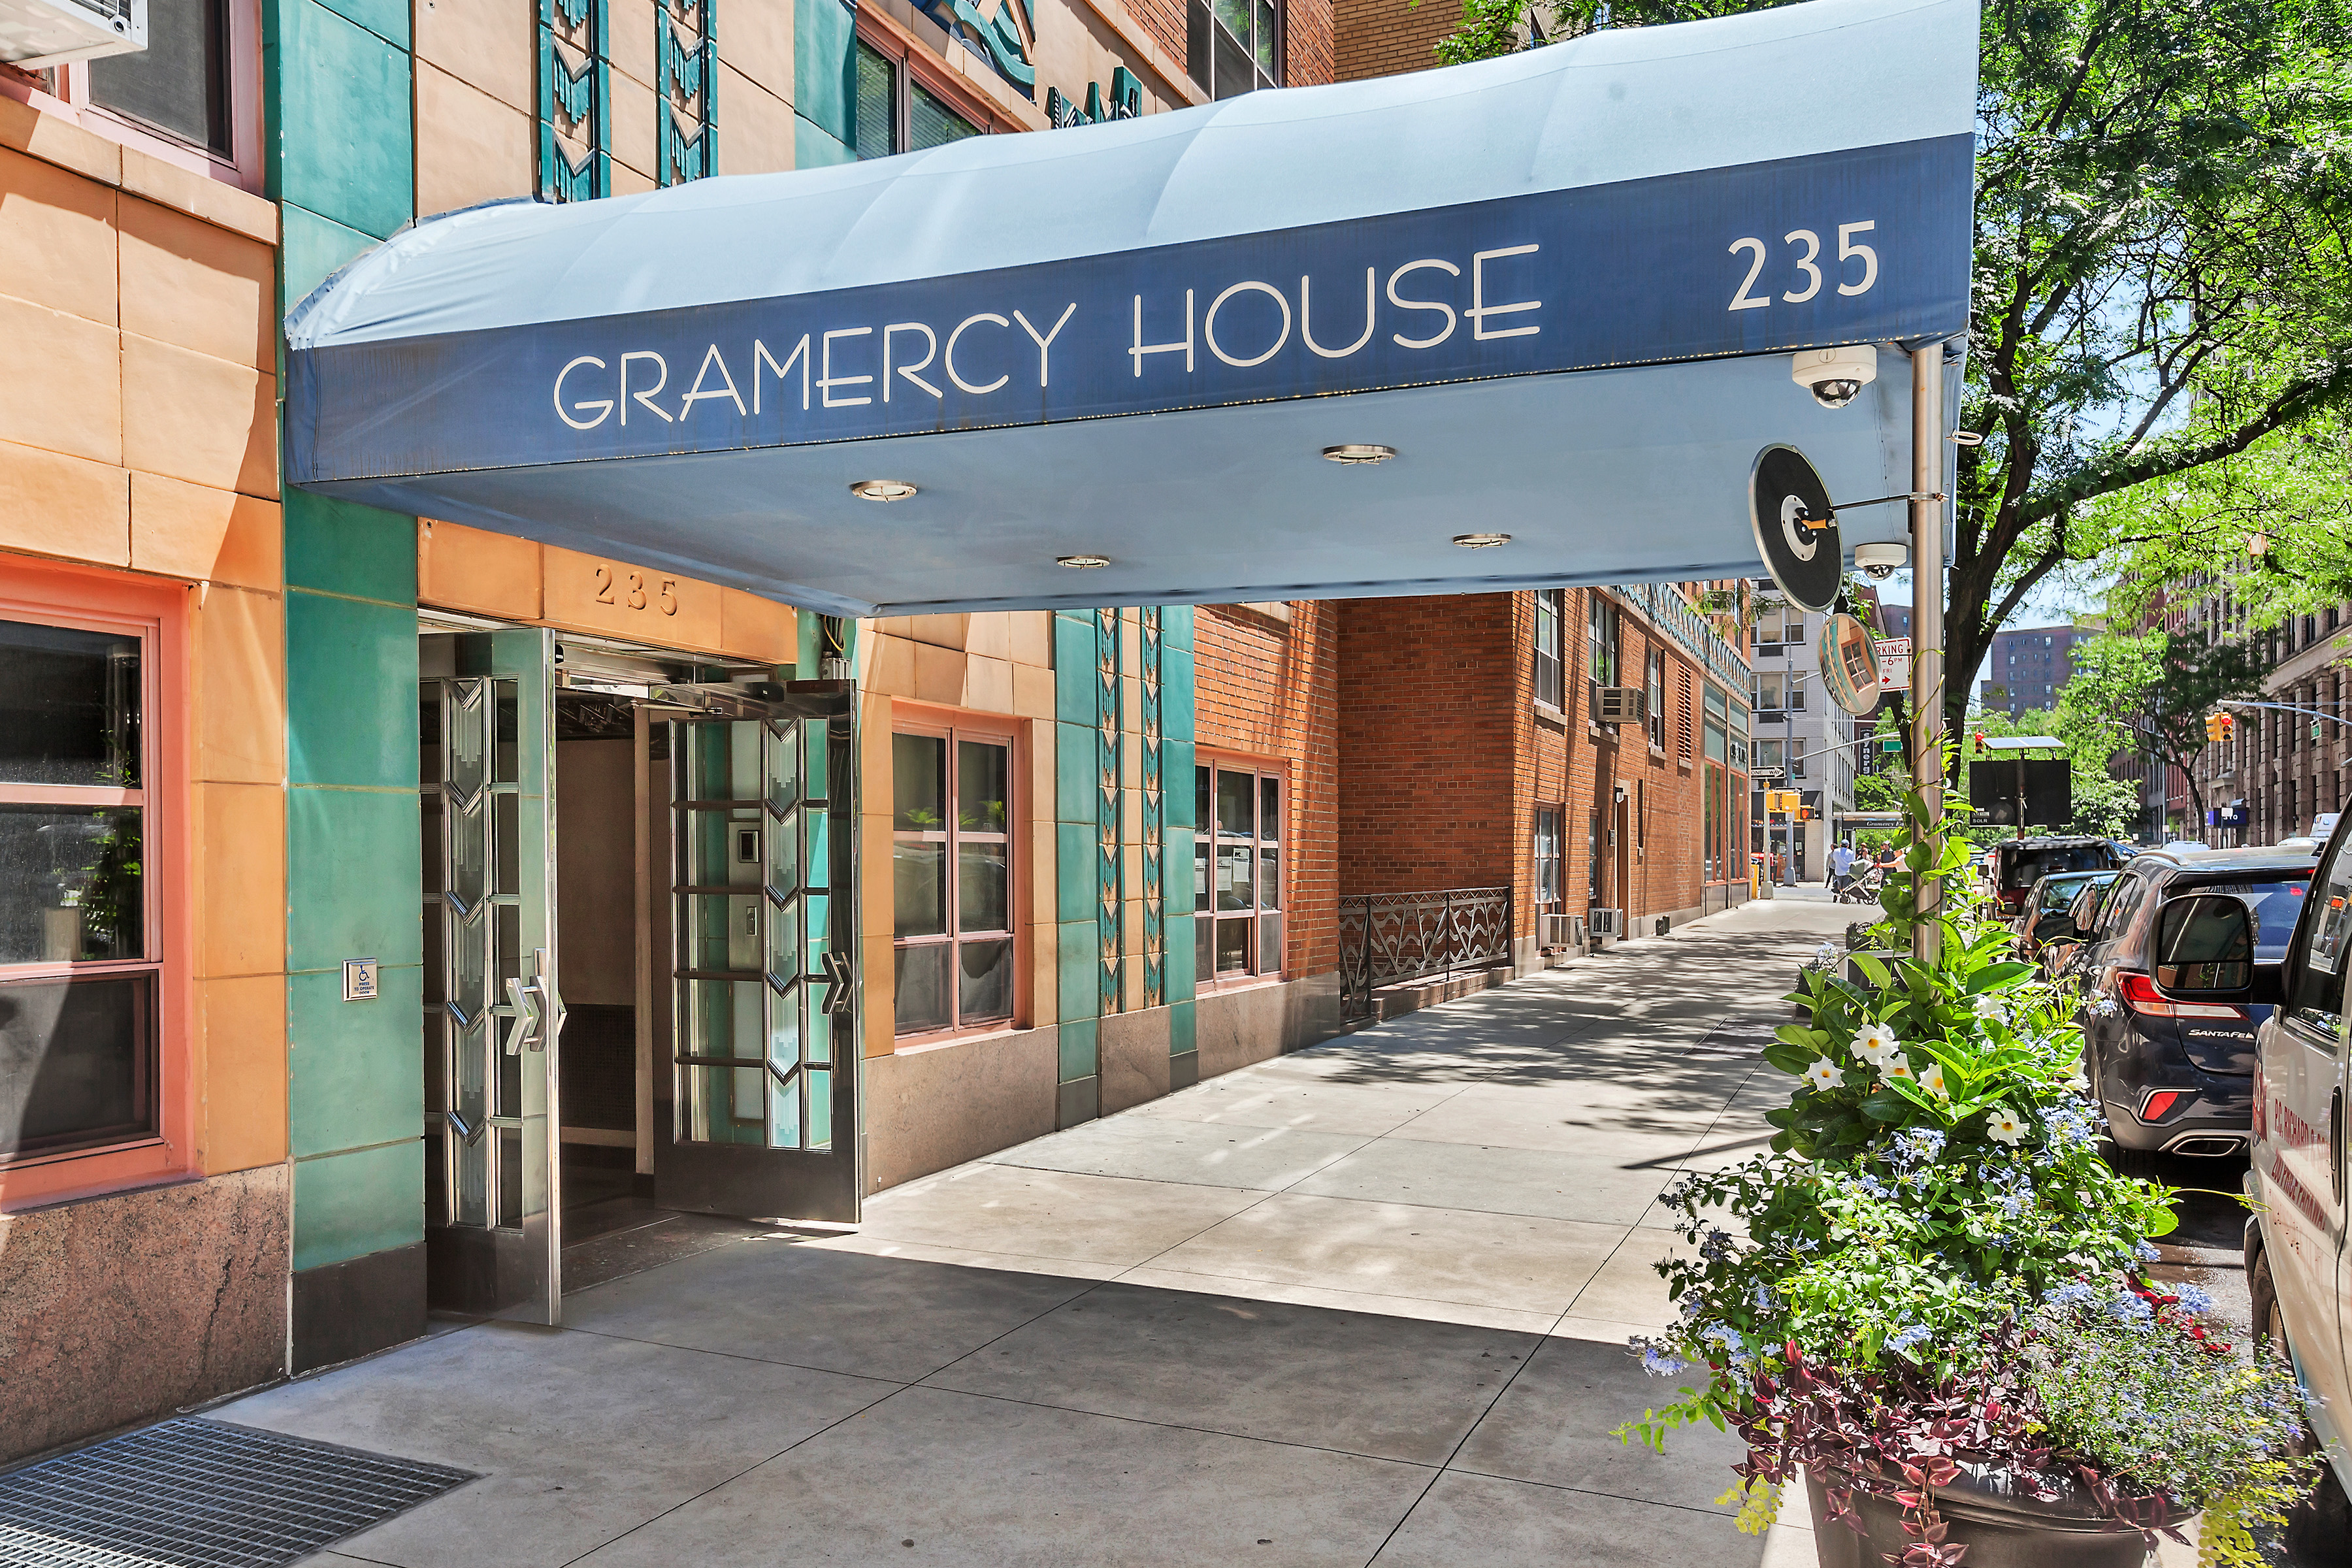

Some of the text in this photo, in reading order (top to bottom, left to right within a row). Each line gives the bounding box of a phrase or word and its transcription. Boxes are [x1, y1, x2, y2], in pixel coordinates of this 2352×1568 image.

[1728, 220, 1878, 311] 235
[553, 243, 1542, 430] GRAMERCY HOUSE
[595, 563, 678, 616] 235
[1876, 644, 1903, 655] RKING
[2284, 1105, 2310, 1161] RICHARD
